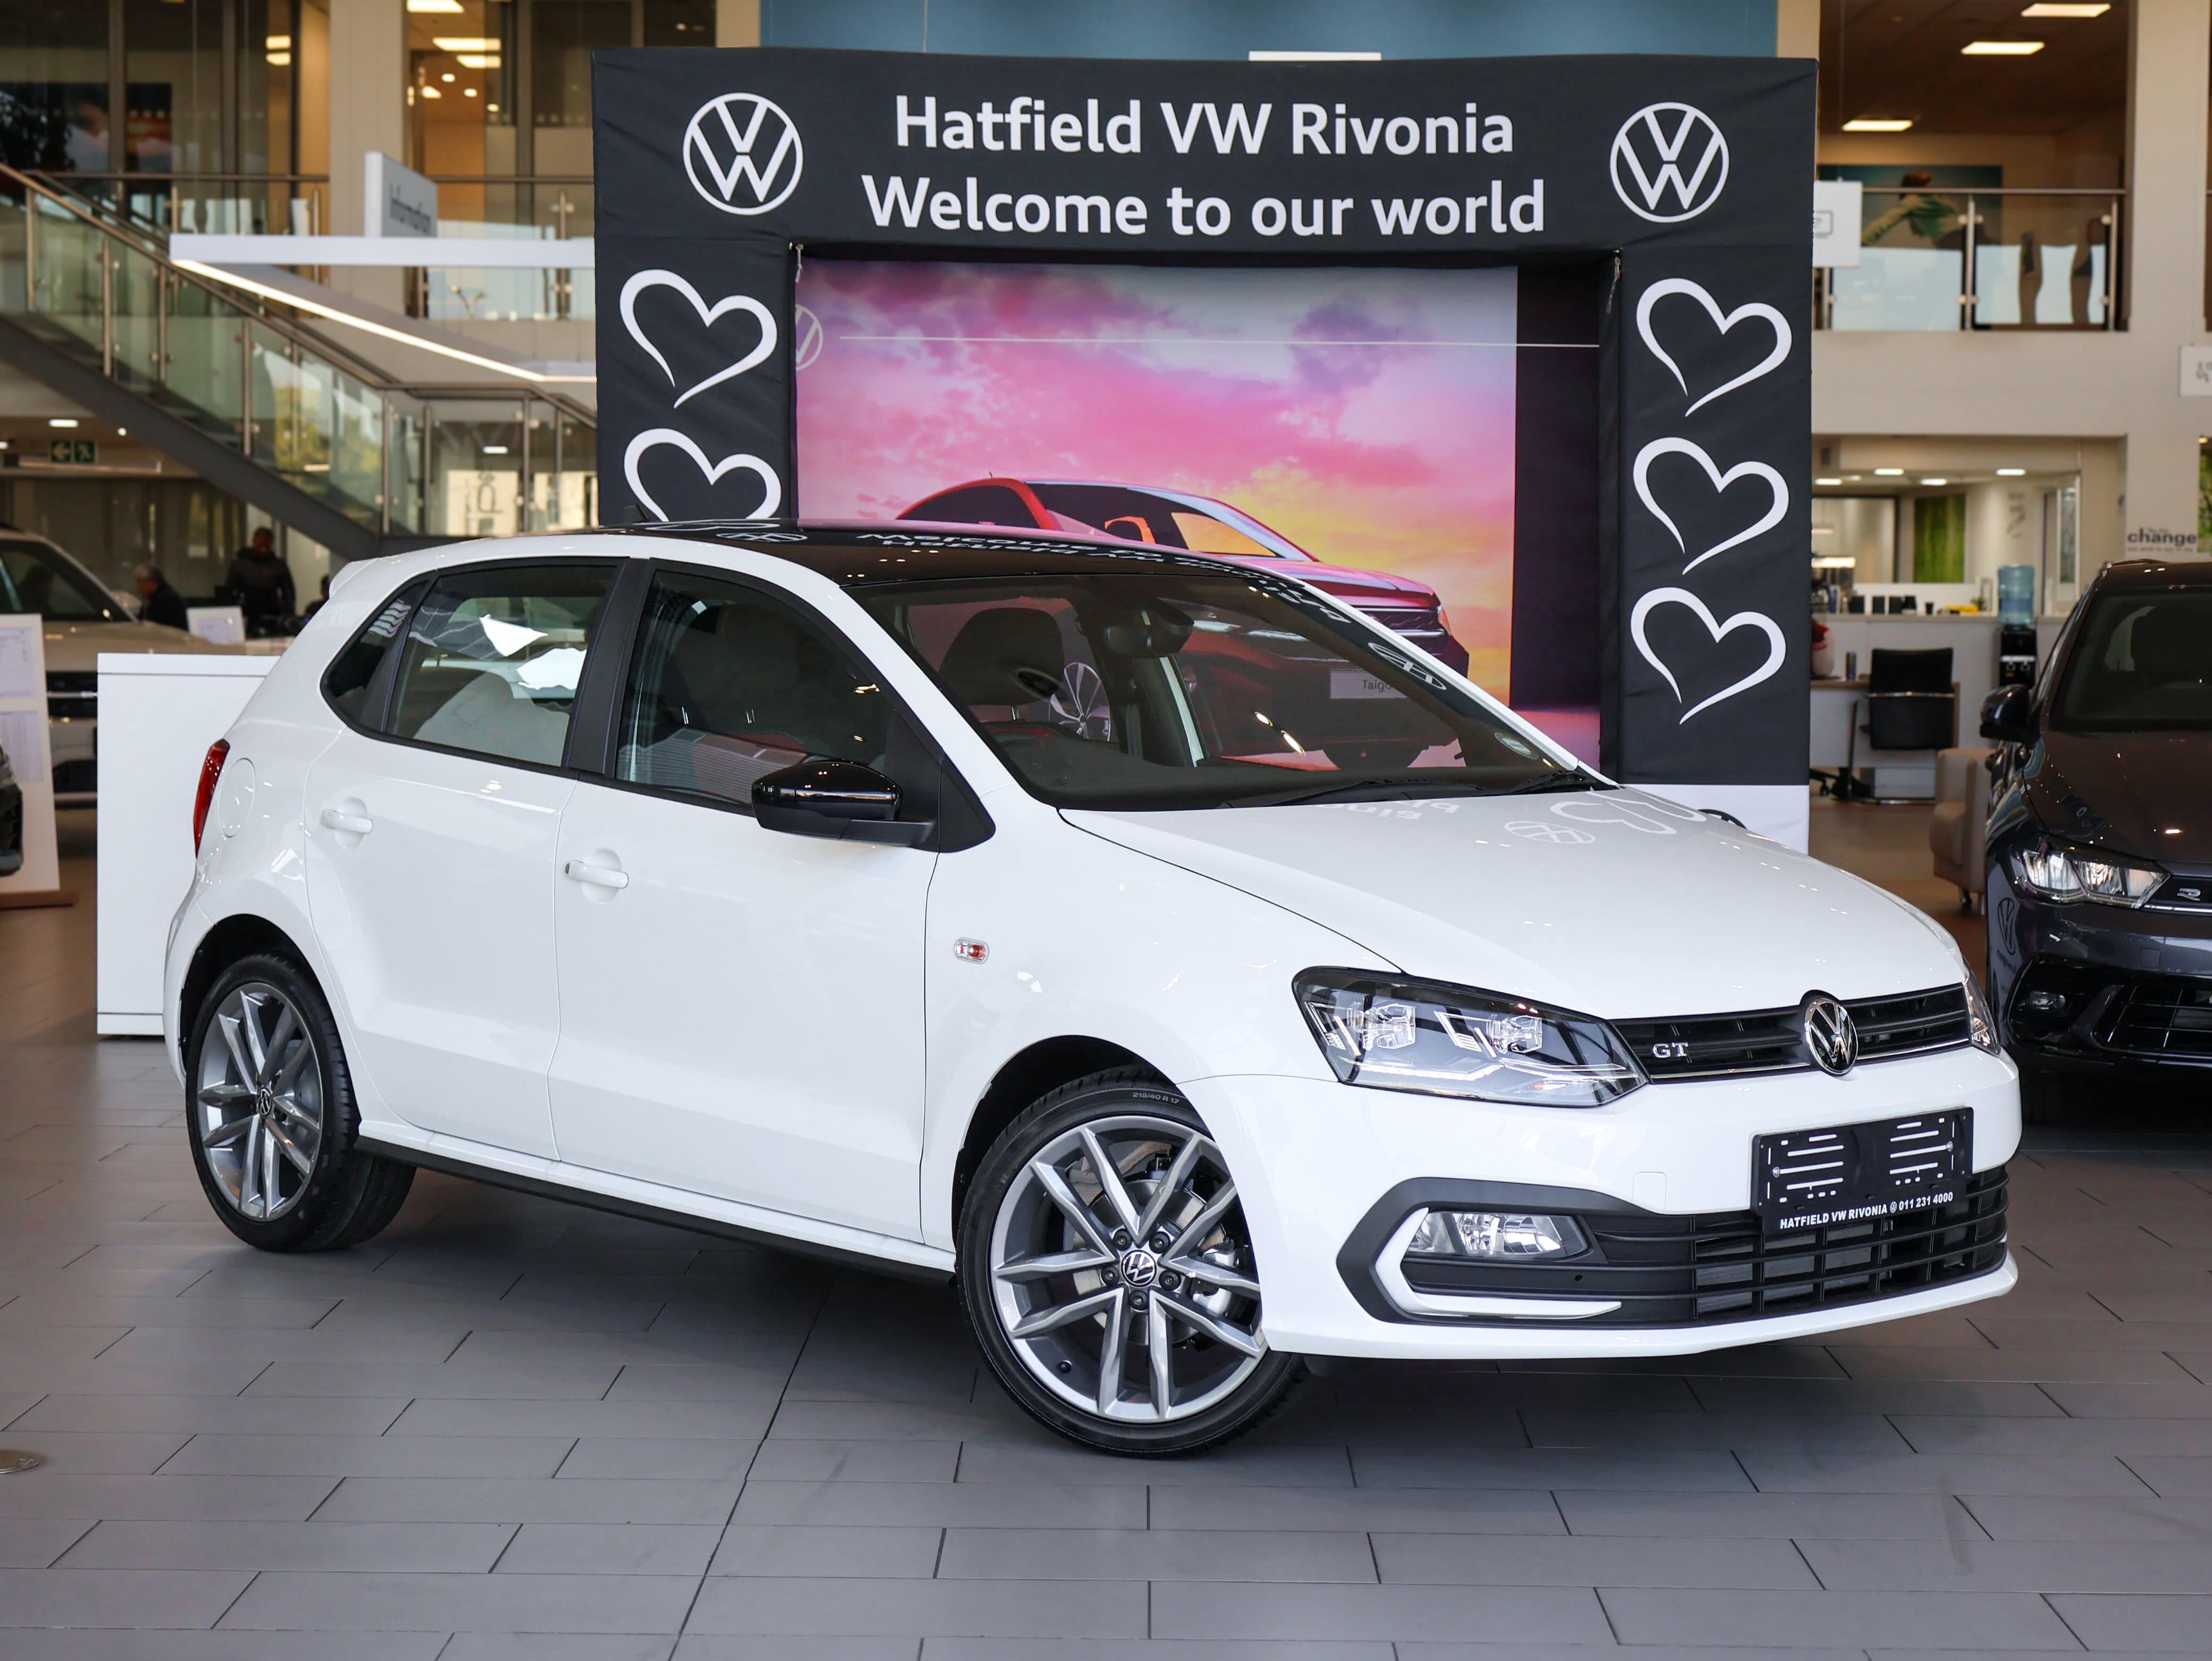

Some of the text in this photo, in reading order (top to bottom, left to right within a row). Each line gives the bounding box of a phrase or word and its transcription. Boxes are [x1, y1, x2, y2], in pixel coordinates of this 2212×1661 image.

[897, 96, 1513, 155] Hatfield VW Rivonia
[861, 175, 1543, 236] Welcome to our world
[2127, 527, 2197, 547] change
[1651, 1041, 1689, 1059] GT
[1780, 1213, 1829, 1230] HATFIELD
[1831, 1210, 1847, 1222] VW
[1848, 1204, 1888, 1220] RIVONIA
[1898, 1198, 1914, 1211] 011
[1915, 1195, 1931, 1208] 231
[1932, 1191, 1954, 1204] 4000
